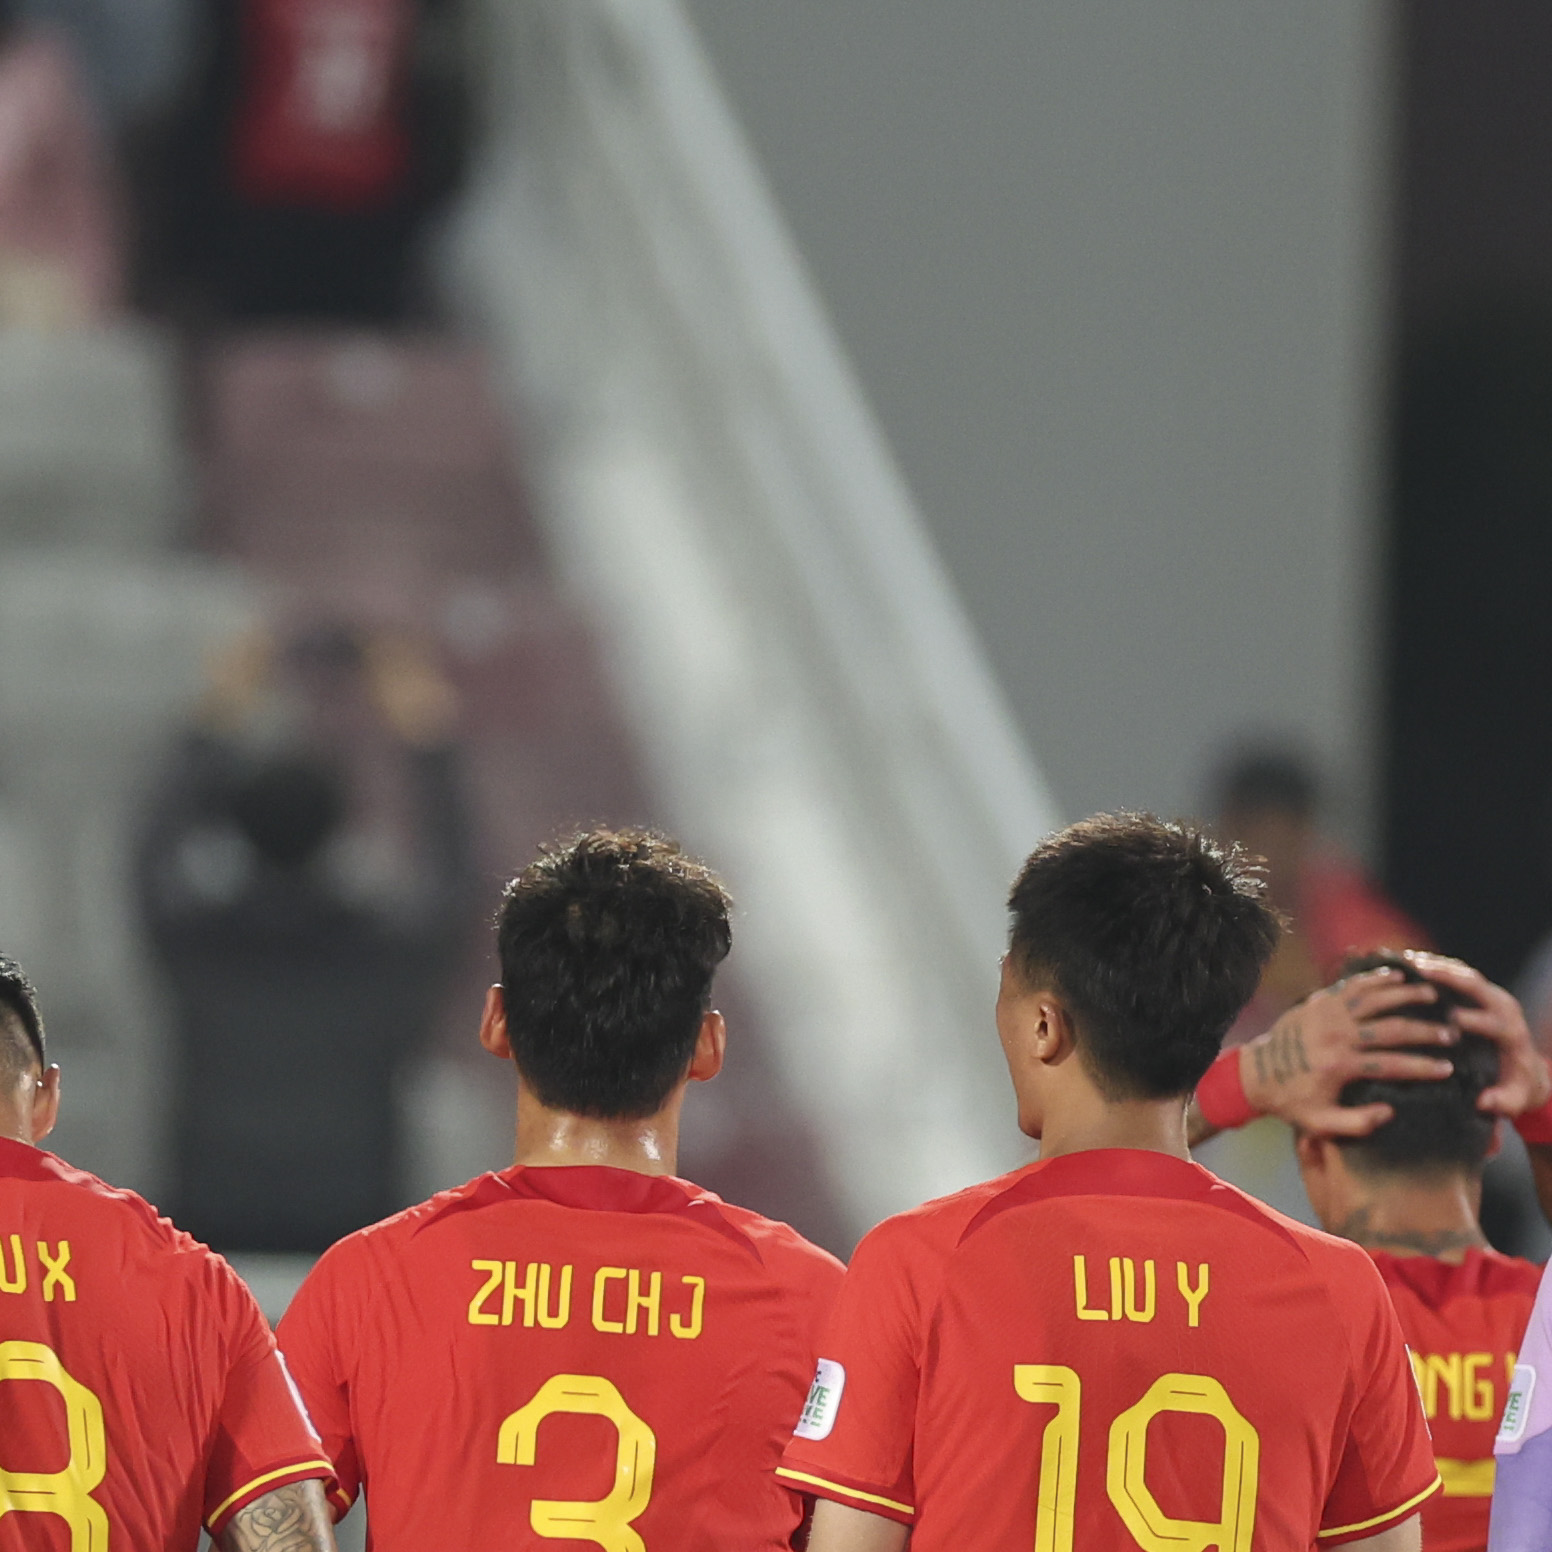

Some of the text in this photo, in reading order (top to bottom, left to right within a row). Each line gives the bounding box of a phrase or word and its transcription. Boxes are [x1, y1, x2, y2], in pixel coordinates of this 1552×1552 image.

[36, 1240, 77, 1302] X
[467, 1259, 573, 1329] ZHU
[1073, 1254, 1210, 1328] LIU Y
